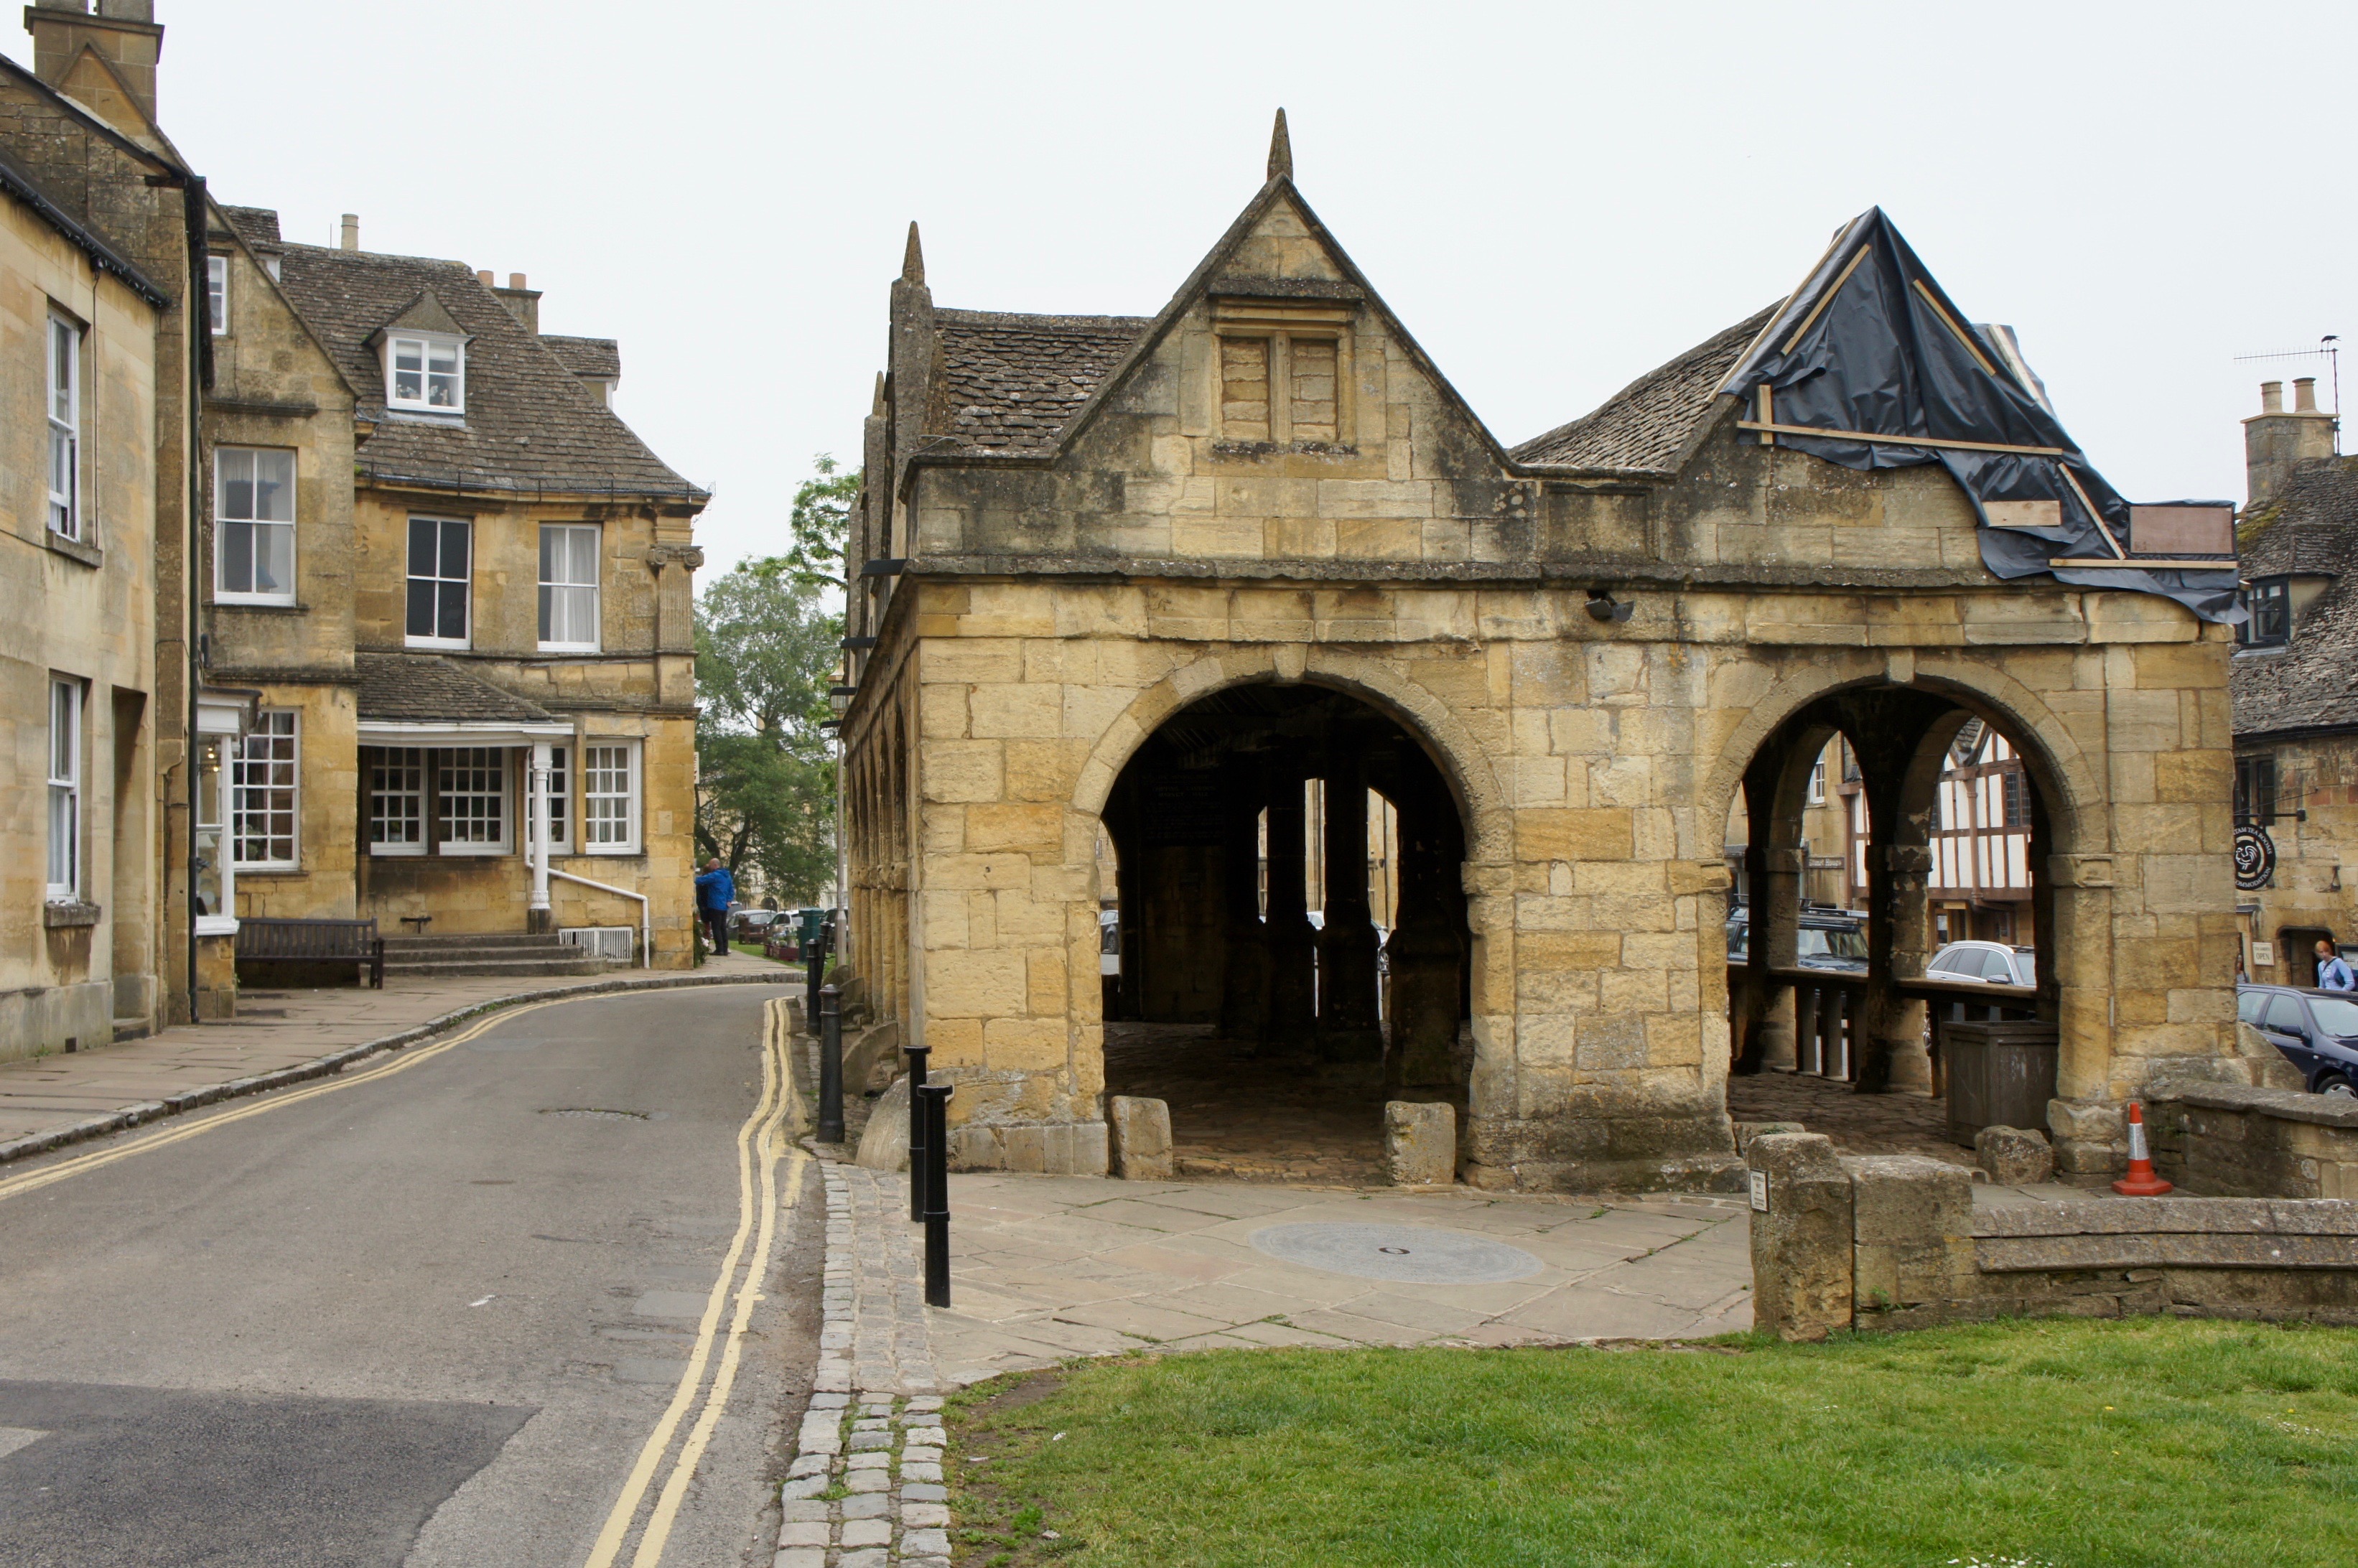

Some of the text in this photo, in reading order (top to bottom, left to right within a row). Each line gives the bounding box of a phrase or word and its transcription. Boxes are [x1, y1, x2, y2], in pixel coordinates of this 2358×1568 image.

[2247, 827, 2258, 836] TEA
[2257, 832, 2273, 854] ROOMS
[2235, 866, 2272, 887] OMMODATION
[2256, 950, 2270, 960] OPEN
